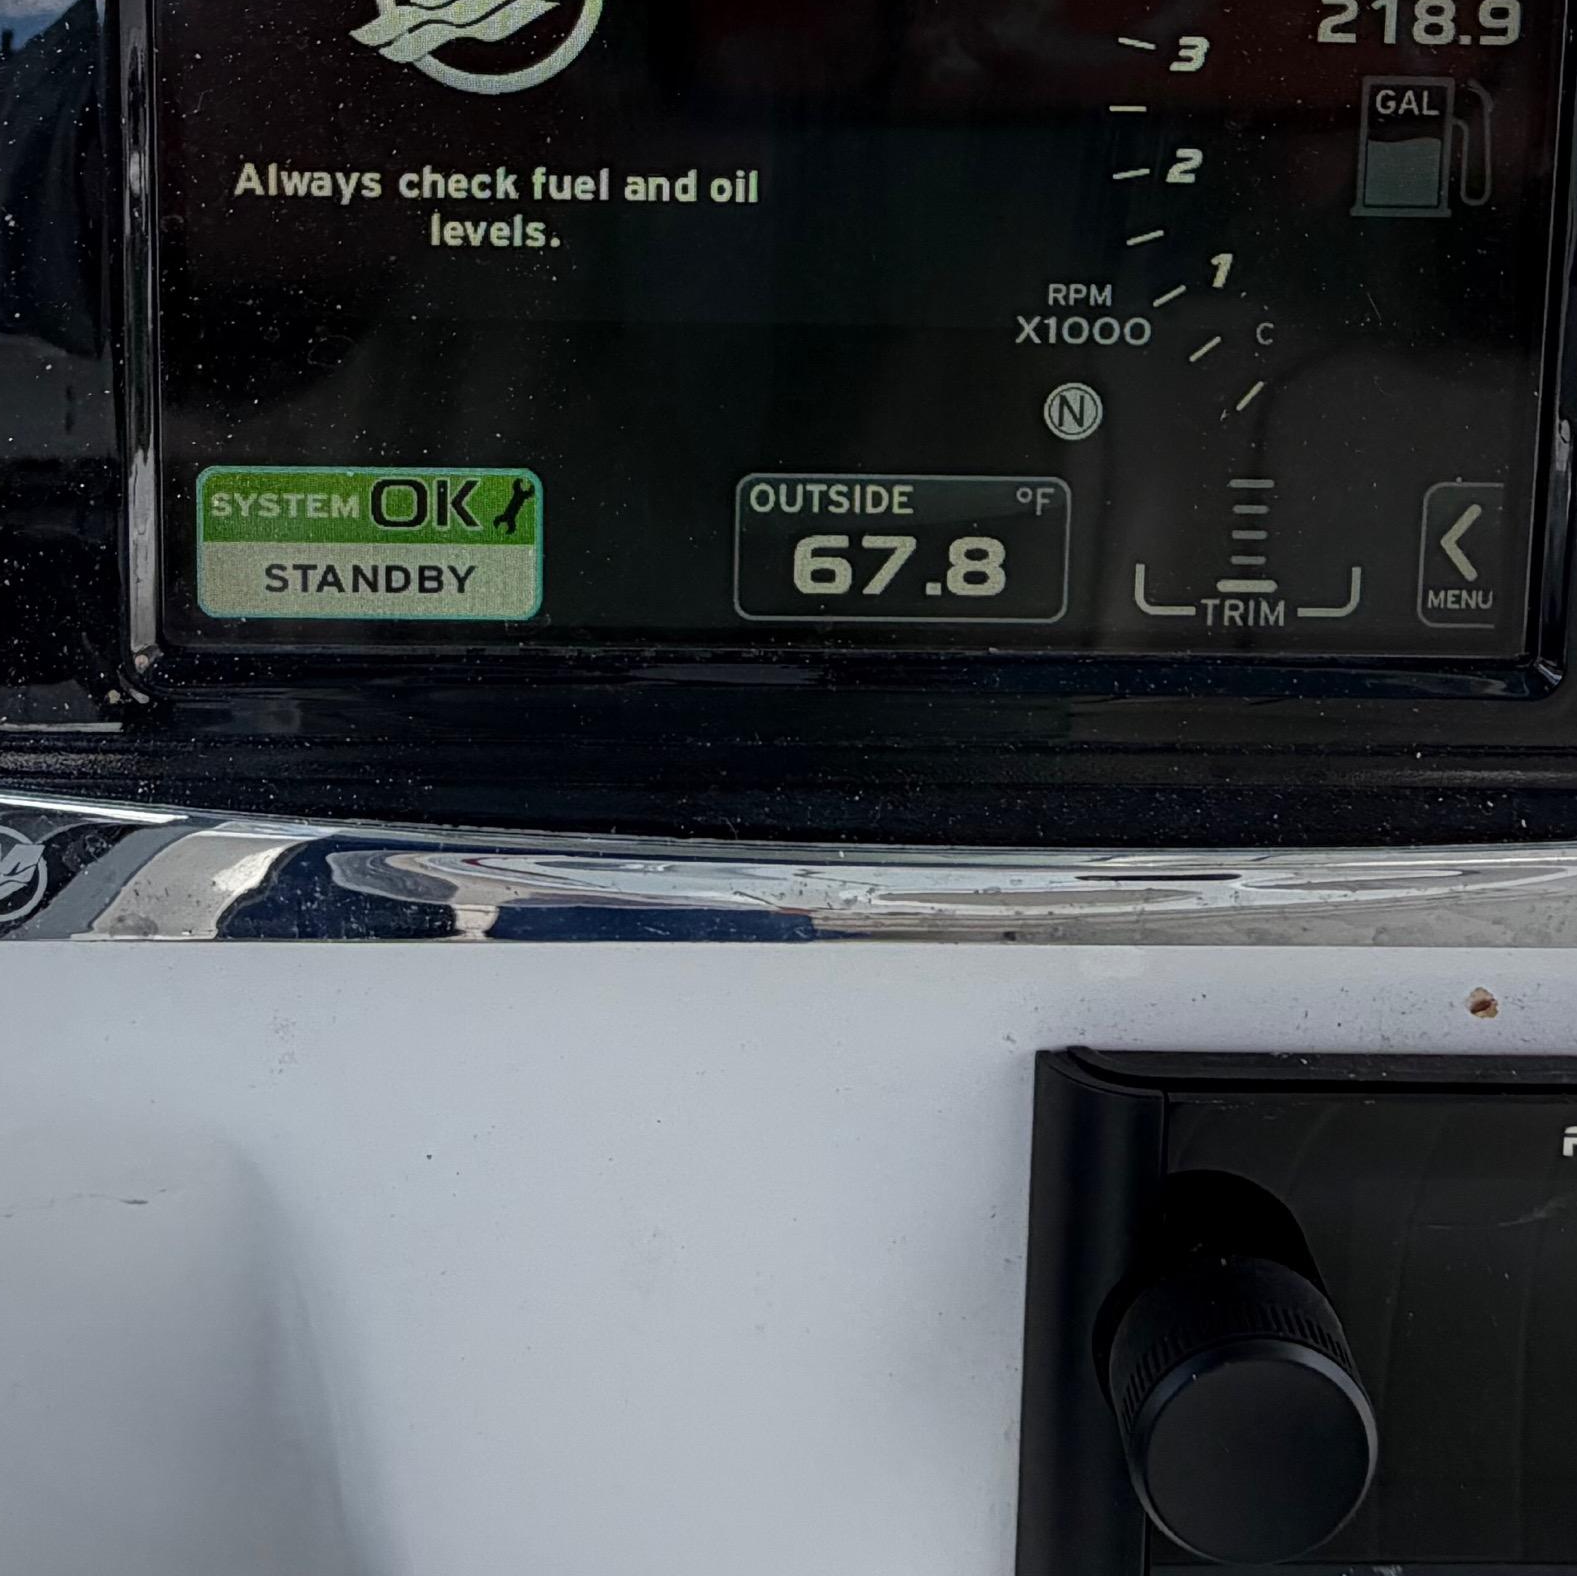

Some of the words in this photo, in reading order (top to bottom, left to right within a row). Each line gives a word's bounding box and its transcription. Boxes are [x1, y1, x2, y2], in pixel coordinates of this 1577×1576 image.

[1169, 36, 1209, 72] 3
[1374, 88, 1440, 116] GAL
[1165, 148, 1203, 183] 2
[234, 163, 382, 205] Always
[398, 167, 519, 200] check
[532, 168, 609, 201] fuel
[624, 169, 697, 203] and
[709, 170, 759, 204] oil
[430, 213, 561, 247] levels.
[1210, 253, 1233, 288] 1
[1048, 284, 1113, 307] RPM
[1015, 316, 1151, 346] X1000
[210, 492, 360, 519] SYSTEM
[369, 478, 482, 532] OK
[749, 482, 914, 516] OUTSIDE
[264, 562, 480, 595] STANDBY
[793, 535, 1006, 597] 67.8
[1200, 600, 1286, 627] TRIM
[1427, 589, 1494, 610] MENU
